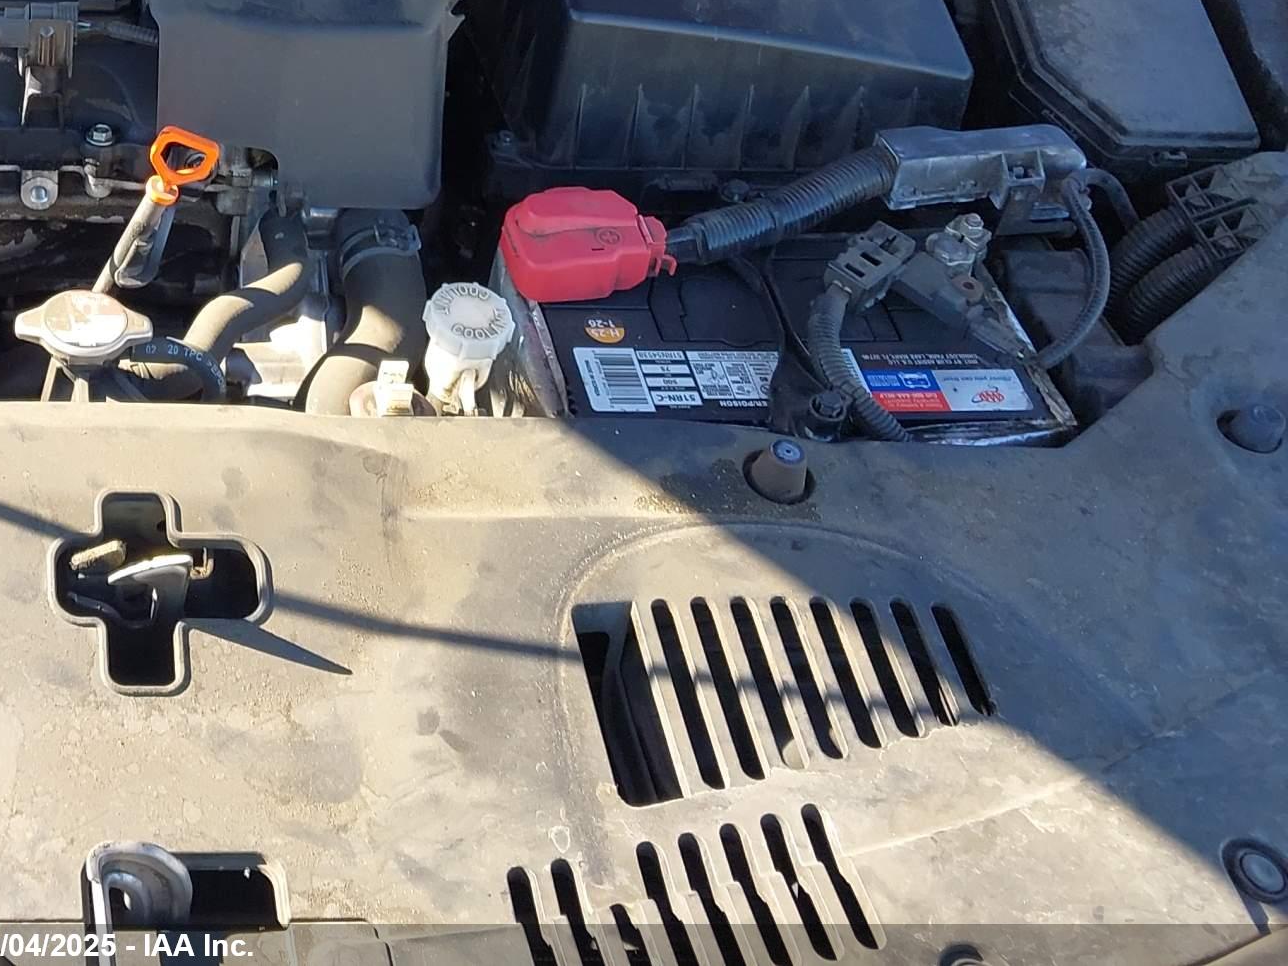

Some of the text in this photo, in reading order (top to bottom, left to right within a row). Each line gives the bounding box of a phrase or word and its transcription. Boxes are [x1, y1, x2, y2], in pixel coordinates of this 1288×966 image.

[183, 347, 204, 361] TPC
[656, 393, 696, 404] 51RN-C
[979, 391, 1005, 403] AAA
[719, 400, 769, 408] ER/POISON
